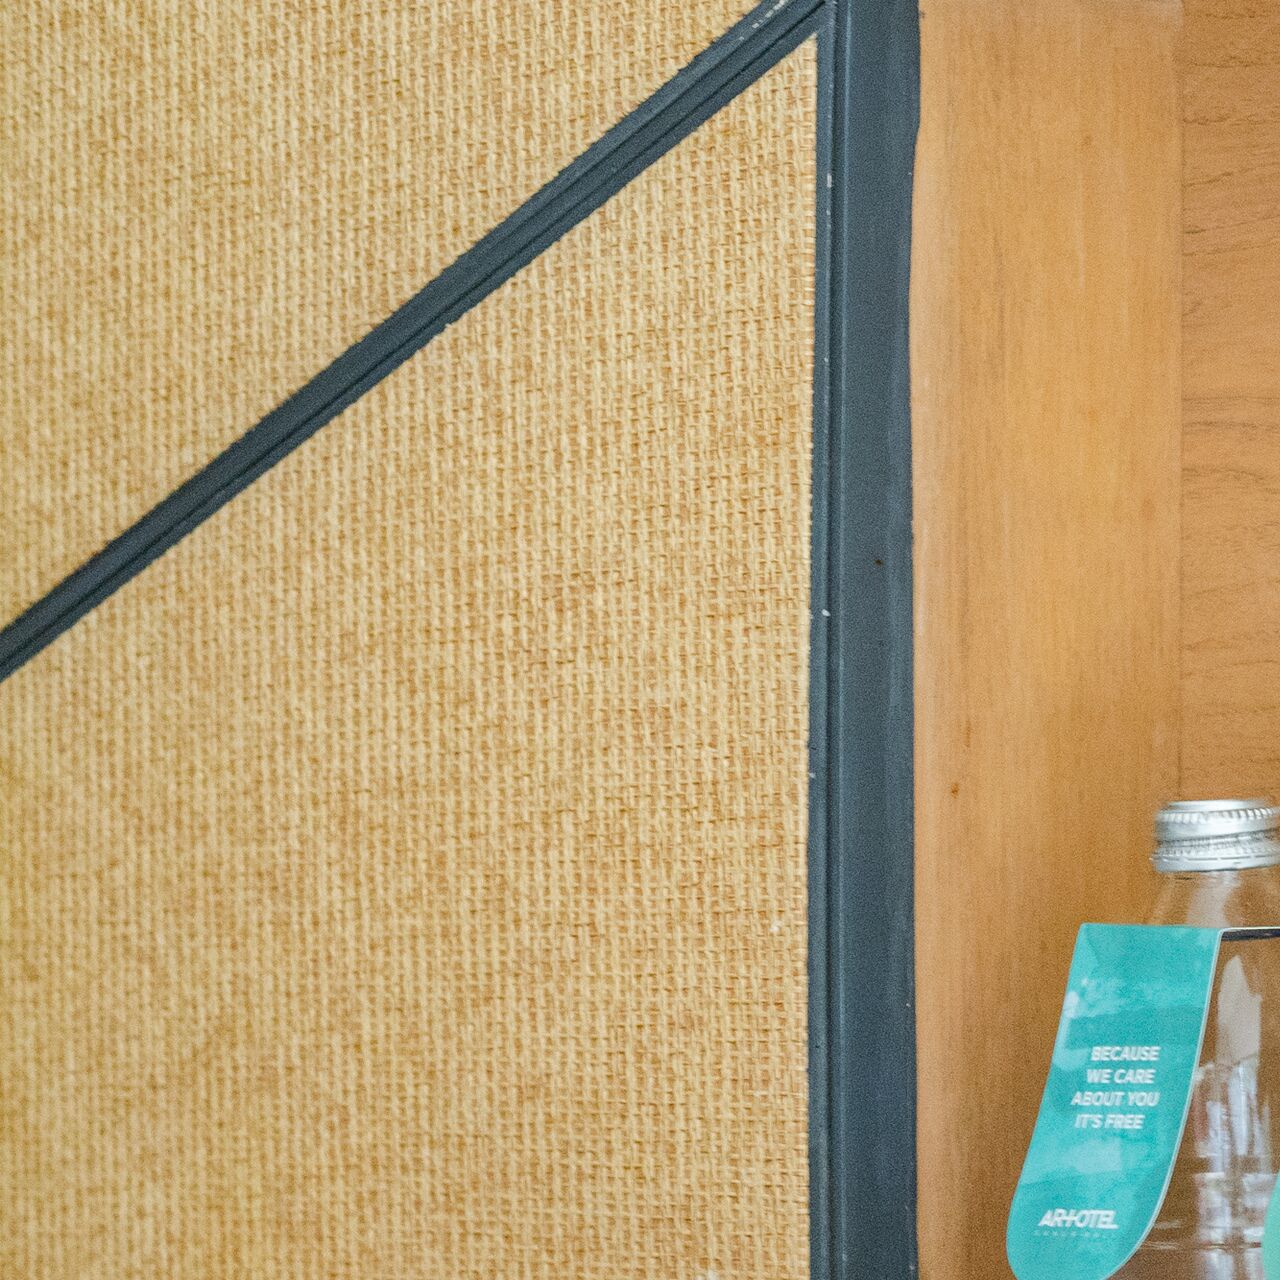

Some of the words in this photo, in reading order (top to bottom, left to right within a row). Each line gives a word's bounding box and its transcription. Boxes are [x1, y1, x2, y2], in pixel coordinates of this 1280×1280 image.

[1091, 1046, 1161, 1061] BECAUSE
[1086, 1069, 1113, 1084] WE
[1114, 1069, 1156, 1084] CARE
[1071, 1091, 1125, 1106] ABOUT
[1127, 1091, 1160, 1106] YOU
[1104, 1114, 1145, 1129] FREE
